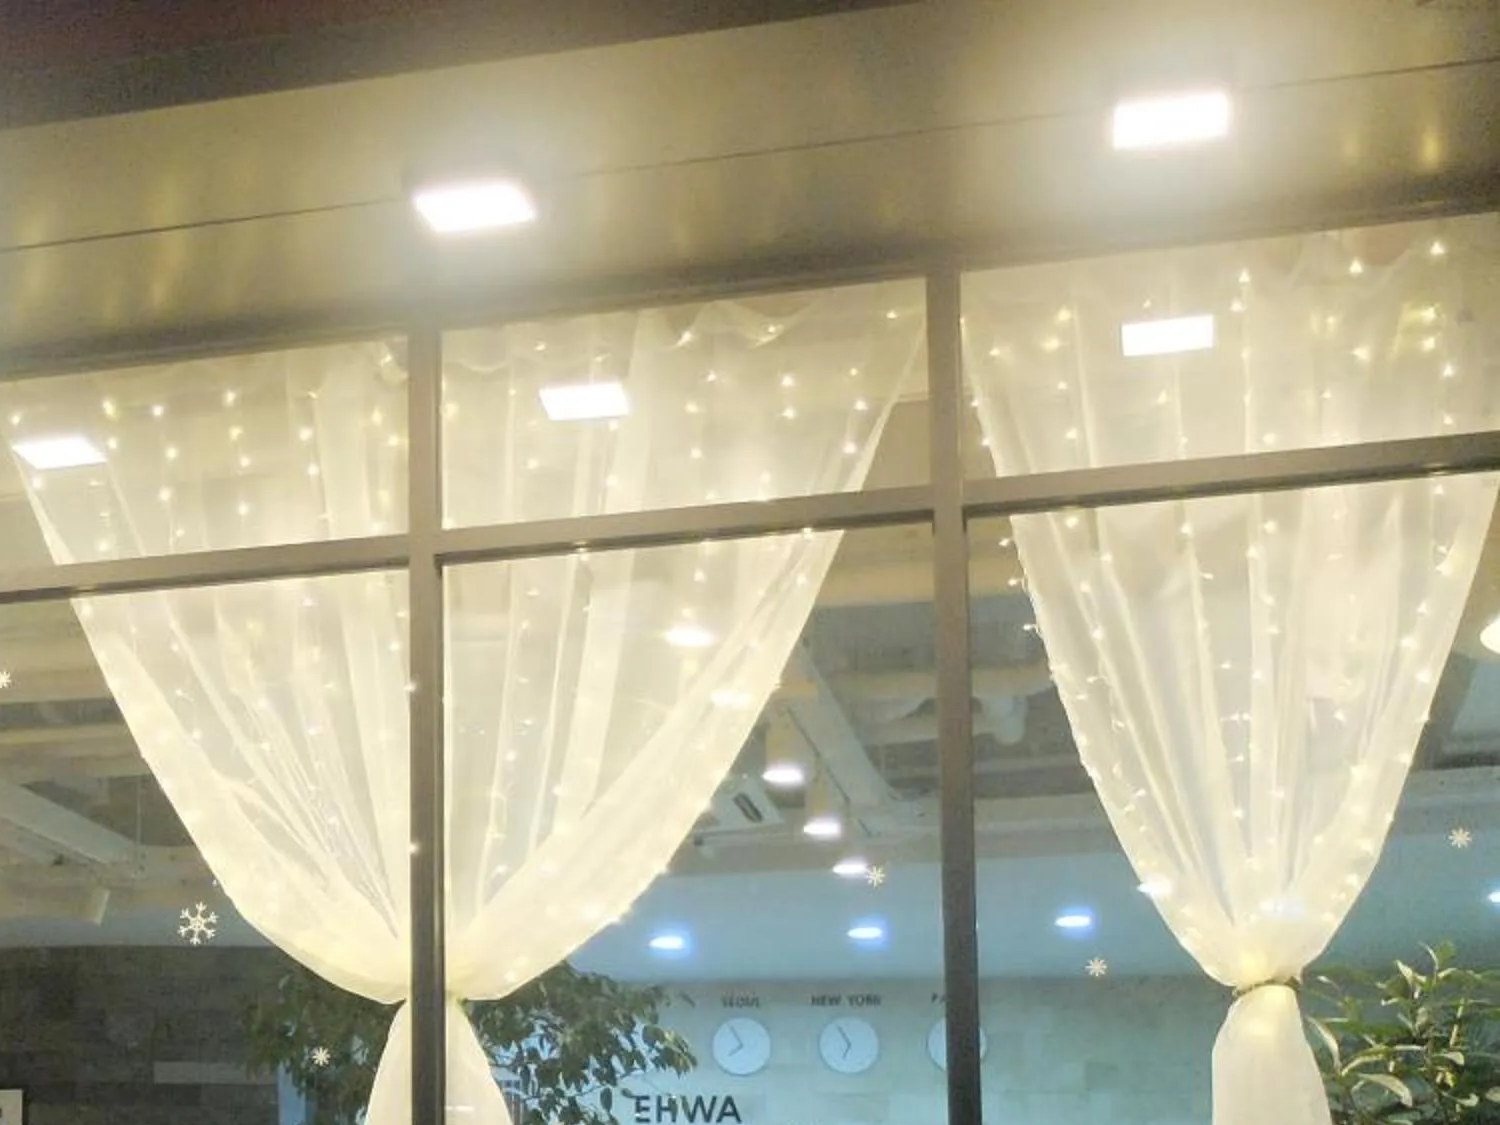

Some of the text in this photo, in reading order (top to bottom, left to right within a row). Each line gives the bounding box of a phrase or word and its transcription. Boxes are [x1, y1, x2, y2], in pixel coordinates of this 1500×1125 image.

[811, 994, 882, 1007] NEW YORK
[634, 1095, 742, 1124] EHWA
